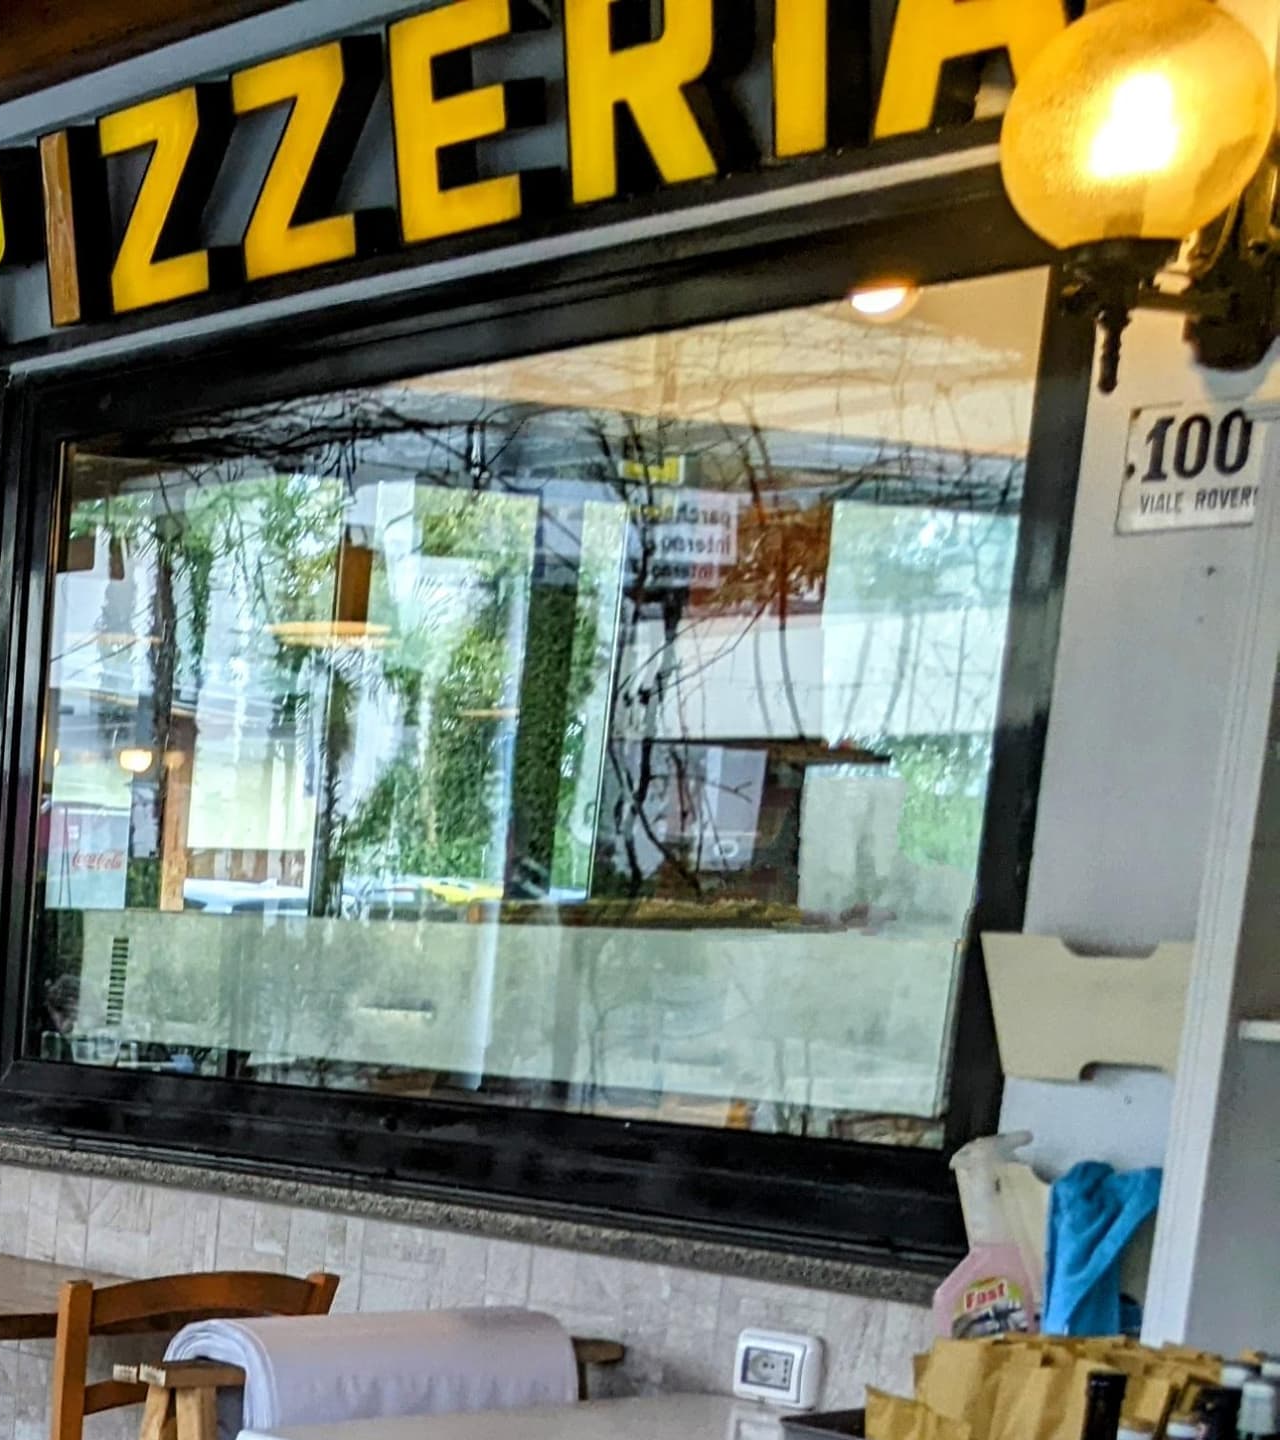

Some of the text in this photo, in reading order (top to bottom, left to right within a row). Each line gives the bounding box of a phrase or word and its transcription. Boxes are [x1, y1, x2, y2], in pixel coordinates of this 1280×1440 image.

[1140, 408, 1254, 484] 100
[1140, 486, 1259, 515] VIALE ROVER
